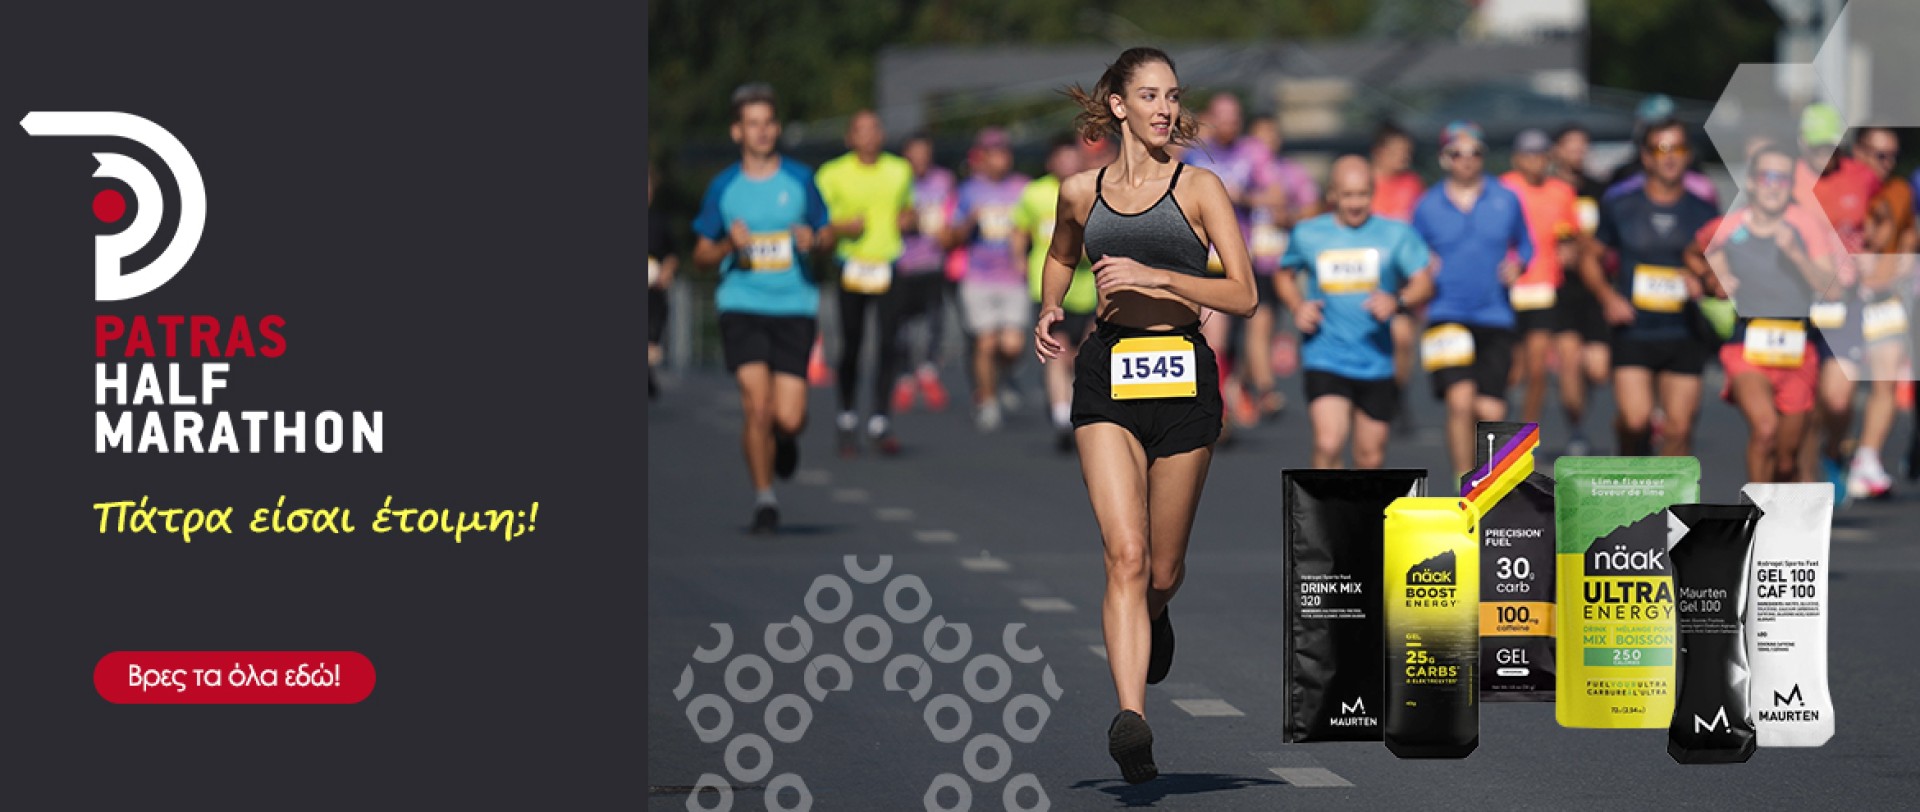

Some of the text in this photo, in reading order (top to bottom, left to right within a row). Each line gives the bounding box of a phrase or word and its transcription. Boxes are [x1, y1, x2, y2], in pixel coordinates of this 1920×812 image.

[1121, 355, 1185, 380] 1545
[1484, 529, 1541, 538] PRECISION
[1484, 538, 1512, 546] FUEL
[1594, 546, 1664, 570] näak
[1412, 568, 1452, 583] näak
[1757, 568, 1816, 582] GEL 100
[1301, 582, 1362, 594] DRINK MIX
[1496, 581, 1530, 592] carb
[1757, 584, 1816, 598] CAF 100
[1406, 588, 1456, 598] BOOST
[1584, 582, 1672, 603] ULTRA
[1680, 587, 1726, 598] Maurten
[1301, 595, 1321, 606] 320
[1406, 600, 1456, 608] ENERGY
[1680, 600, 1720, 612] Gel 100
[1584, 605, 1672, 619] ENERGY
[1584, 635, 1672, 645] MIX BOISSON
[1496, 648, 1530, 664] GEL
[1613, 649, 1642, 660] 250
[1406, 666, 1457, 676] CARBS
[1758, 710, 1820, 722] MAURTEN
[1330, 718, 1378, 726] MAURTEN
